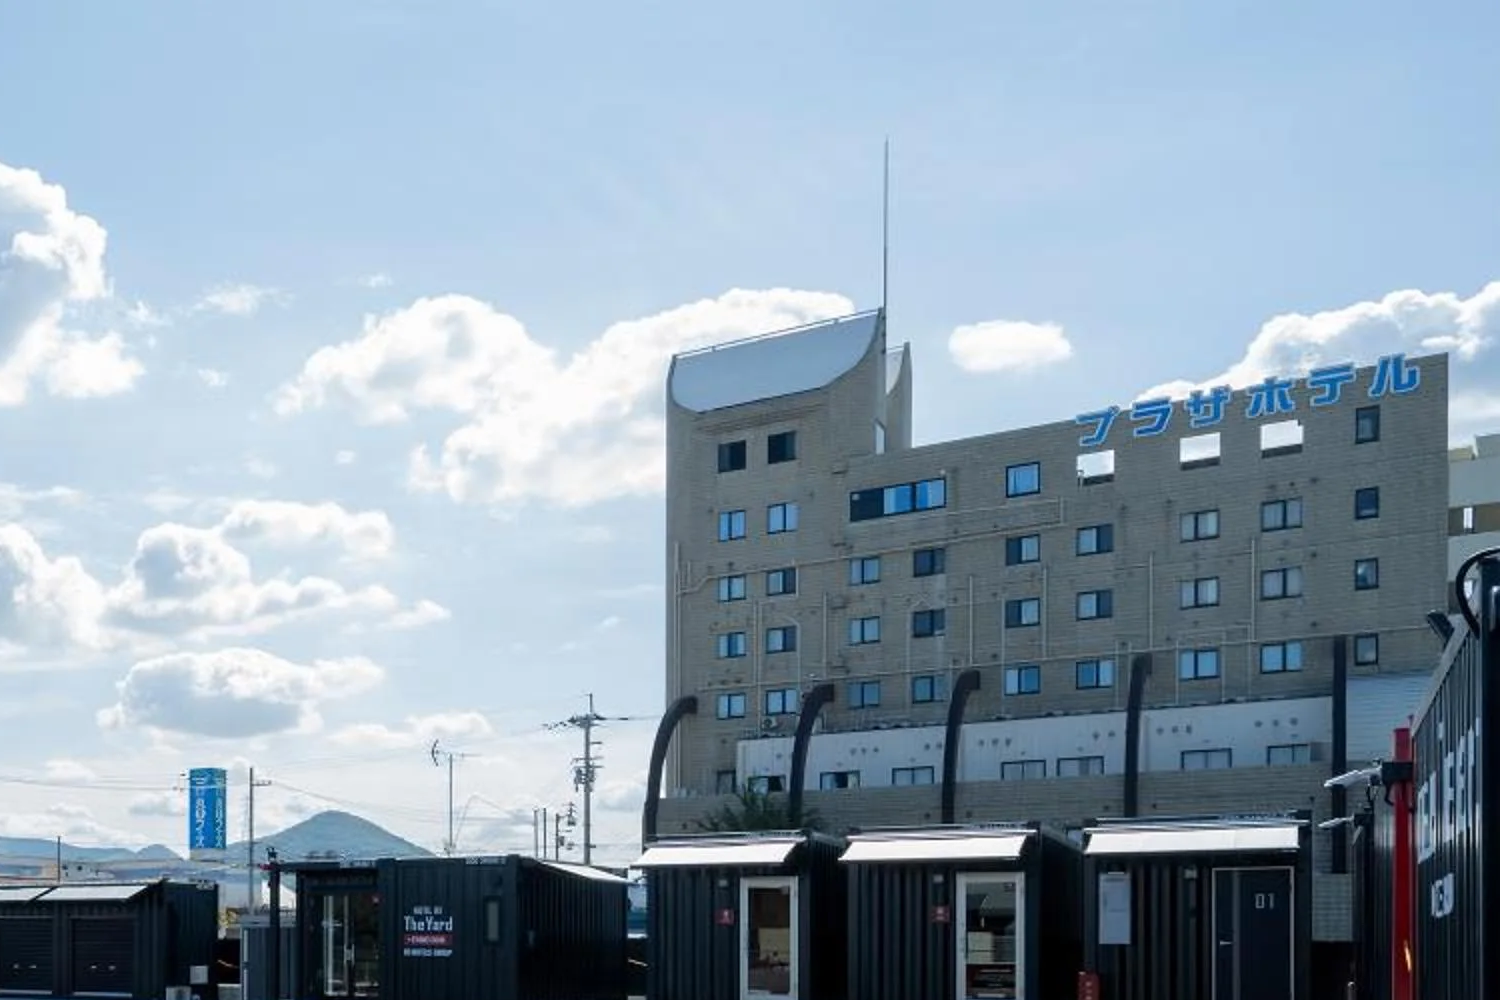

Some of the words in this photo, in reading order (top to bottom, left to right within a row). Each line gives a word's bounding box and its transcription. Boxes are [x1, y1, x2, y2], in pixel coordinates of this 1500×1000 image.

[1075, 352, 1422, 447] プラザホテル
[1255, 893, 1275, 909] 01
